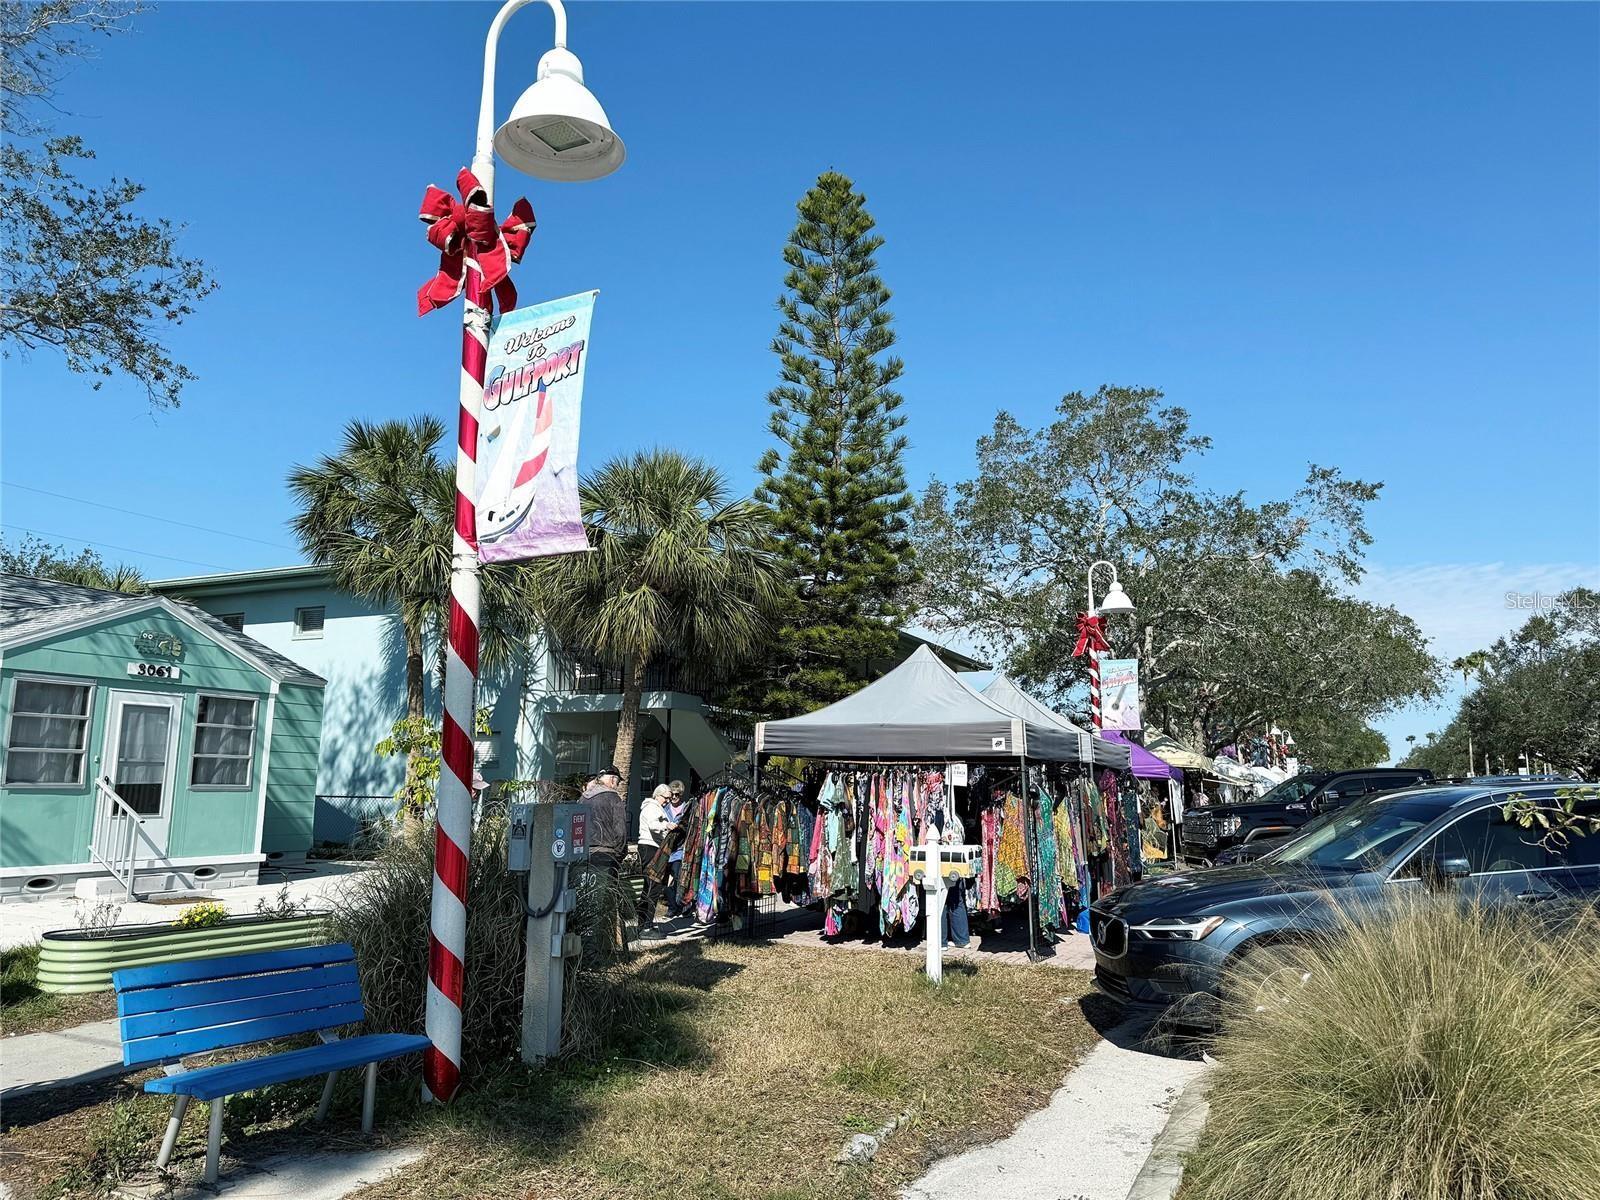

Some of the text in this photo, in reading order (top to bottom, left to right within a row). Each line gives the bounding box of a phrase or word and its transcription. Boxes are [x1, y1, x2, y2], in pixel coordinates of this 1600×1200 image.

[504, 315, 576, 355] Welcome
[526, 343, 548, 362] To
[483, 340, 585, 411] GULFPORT
[138, 663, 172, 678] 3061
[573, 814, 585, 824] EVENT
[575, 826, 583, 835] USE
